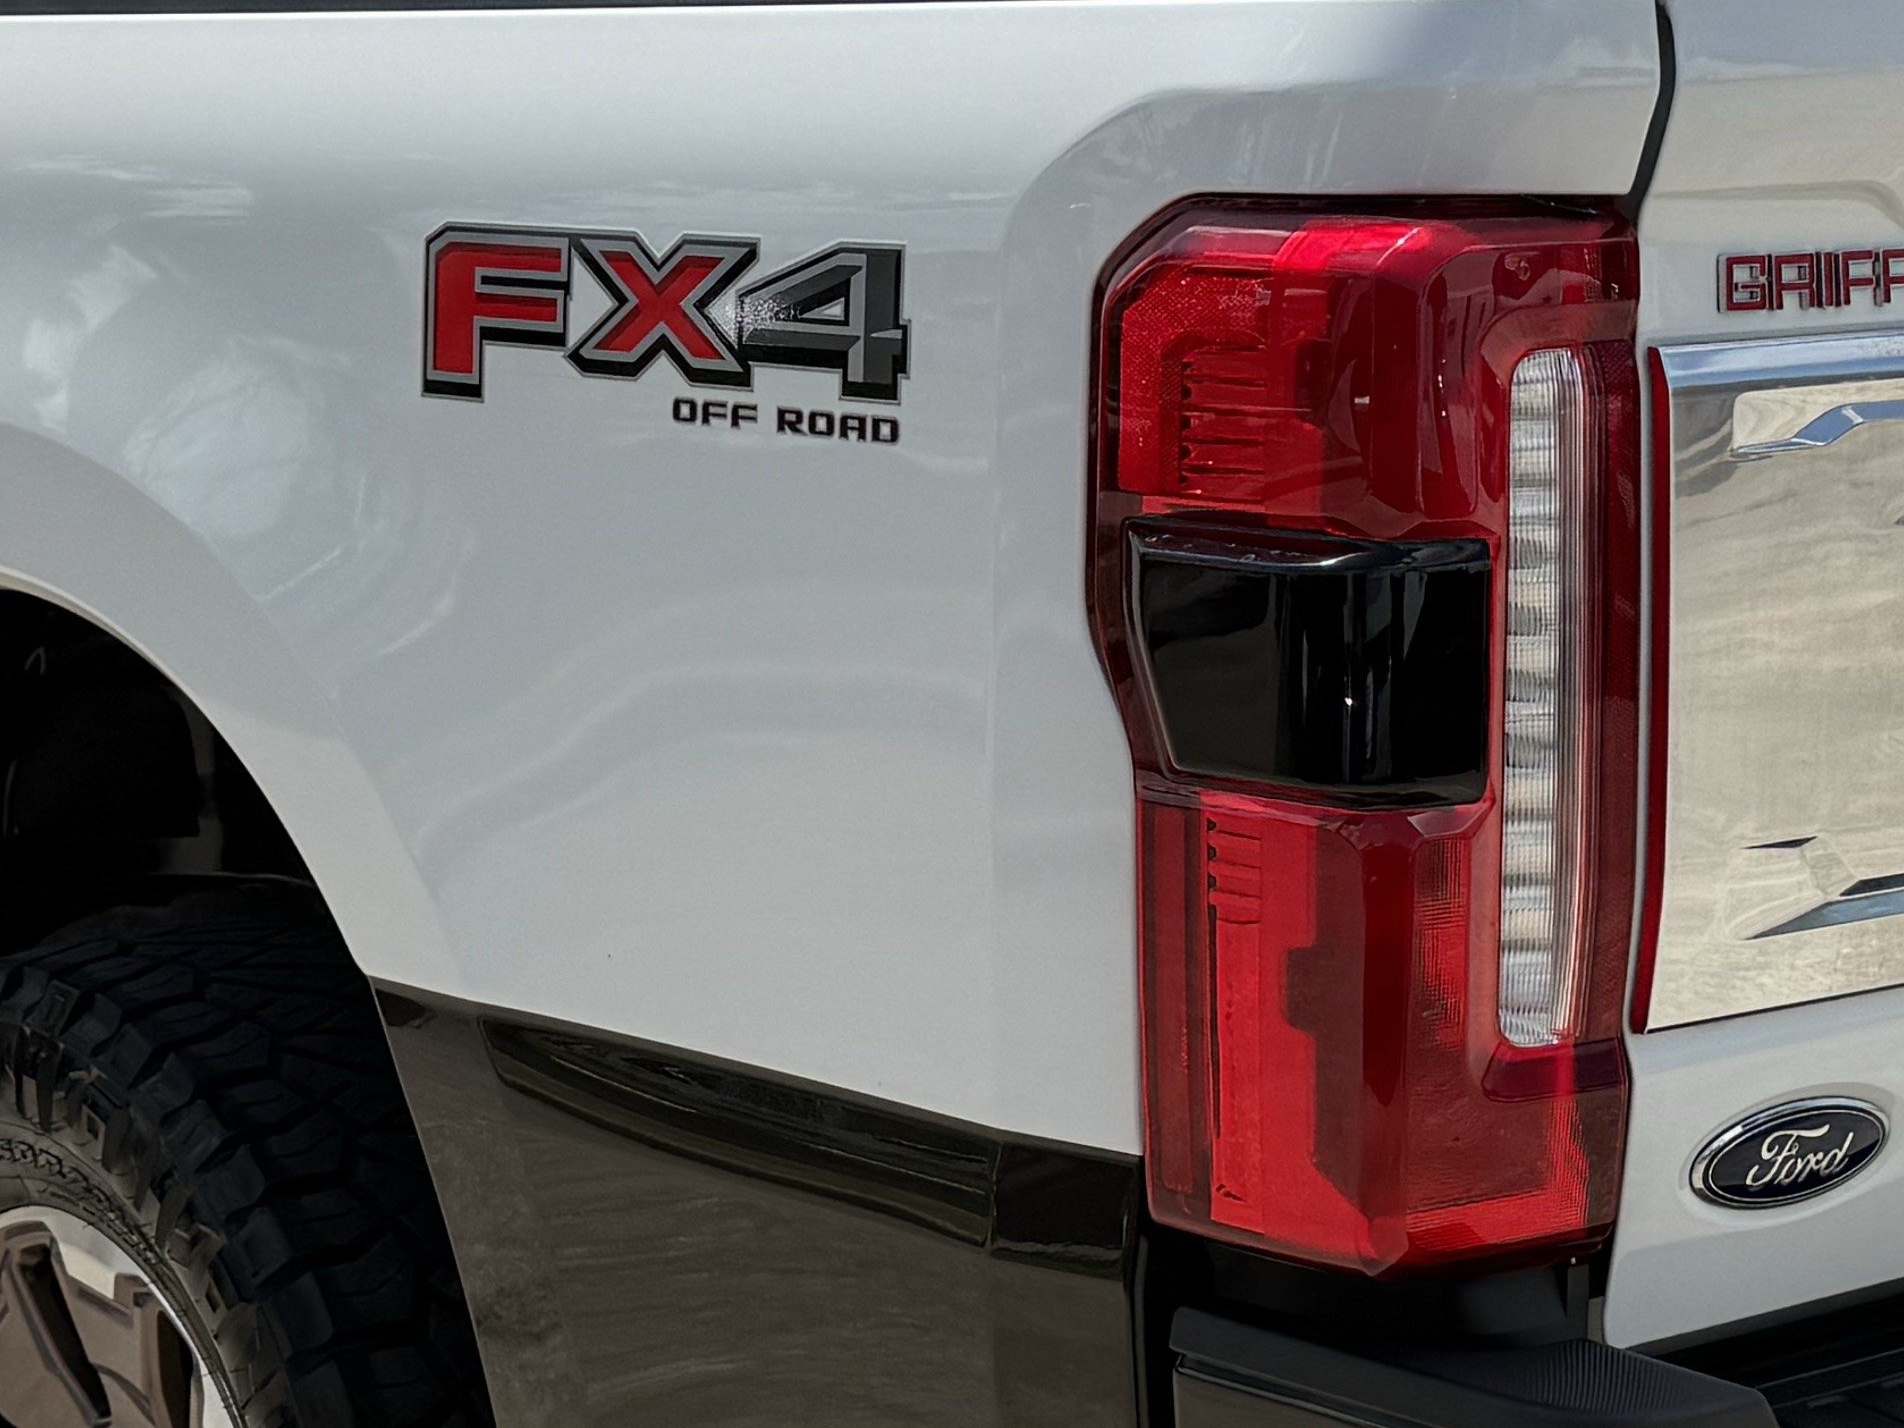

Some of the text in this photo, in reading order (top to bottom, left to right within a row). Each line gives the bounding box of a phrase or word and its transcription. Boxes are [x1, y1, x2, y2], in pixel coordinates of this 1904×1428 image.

[420, 220, 912, 404] FX4
[671, 397, 900, 446] OFF ROAD
[1745, 1123, 1855, 1188] Ford
